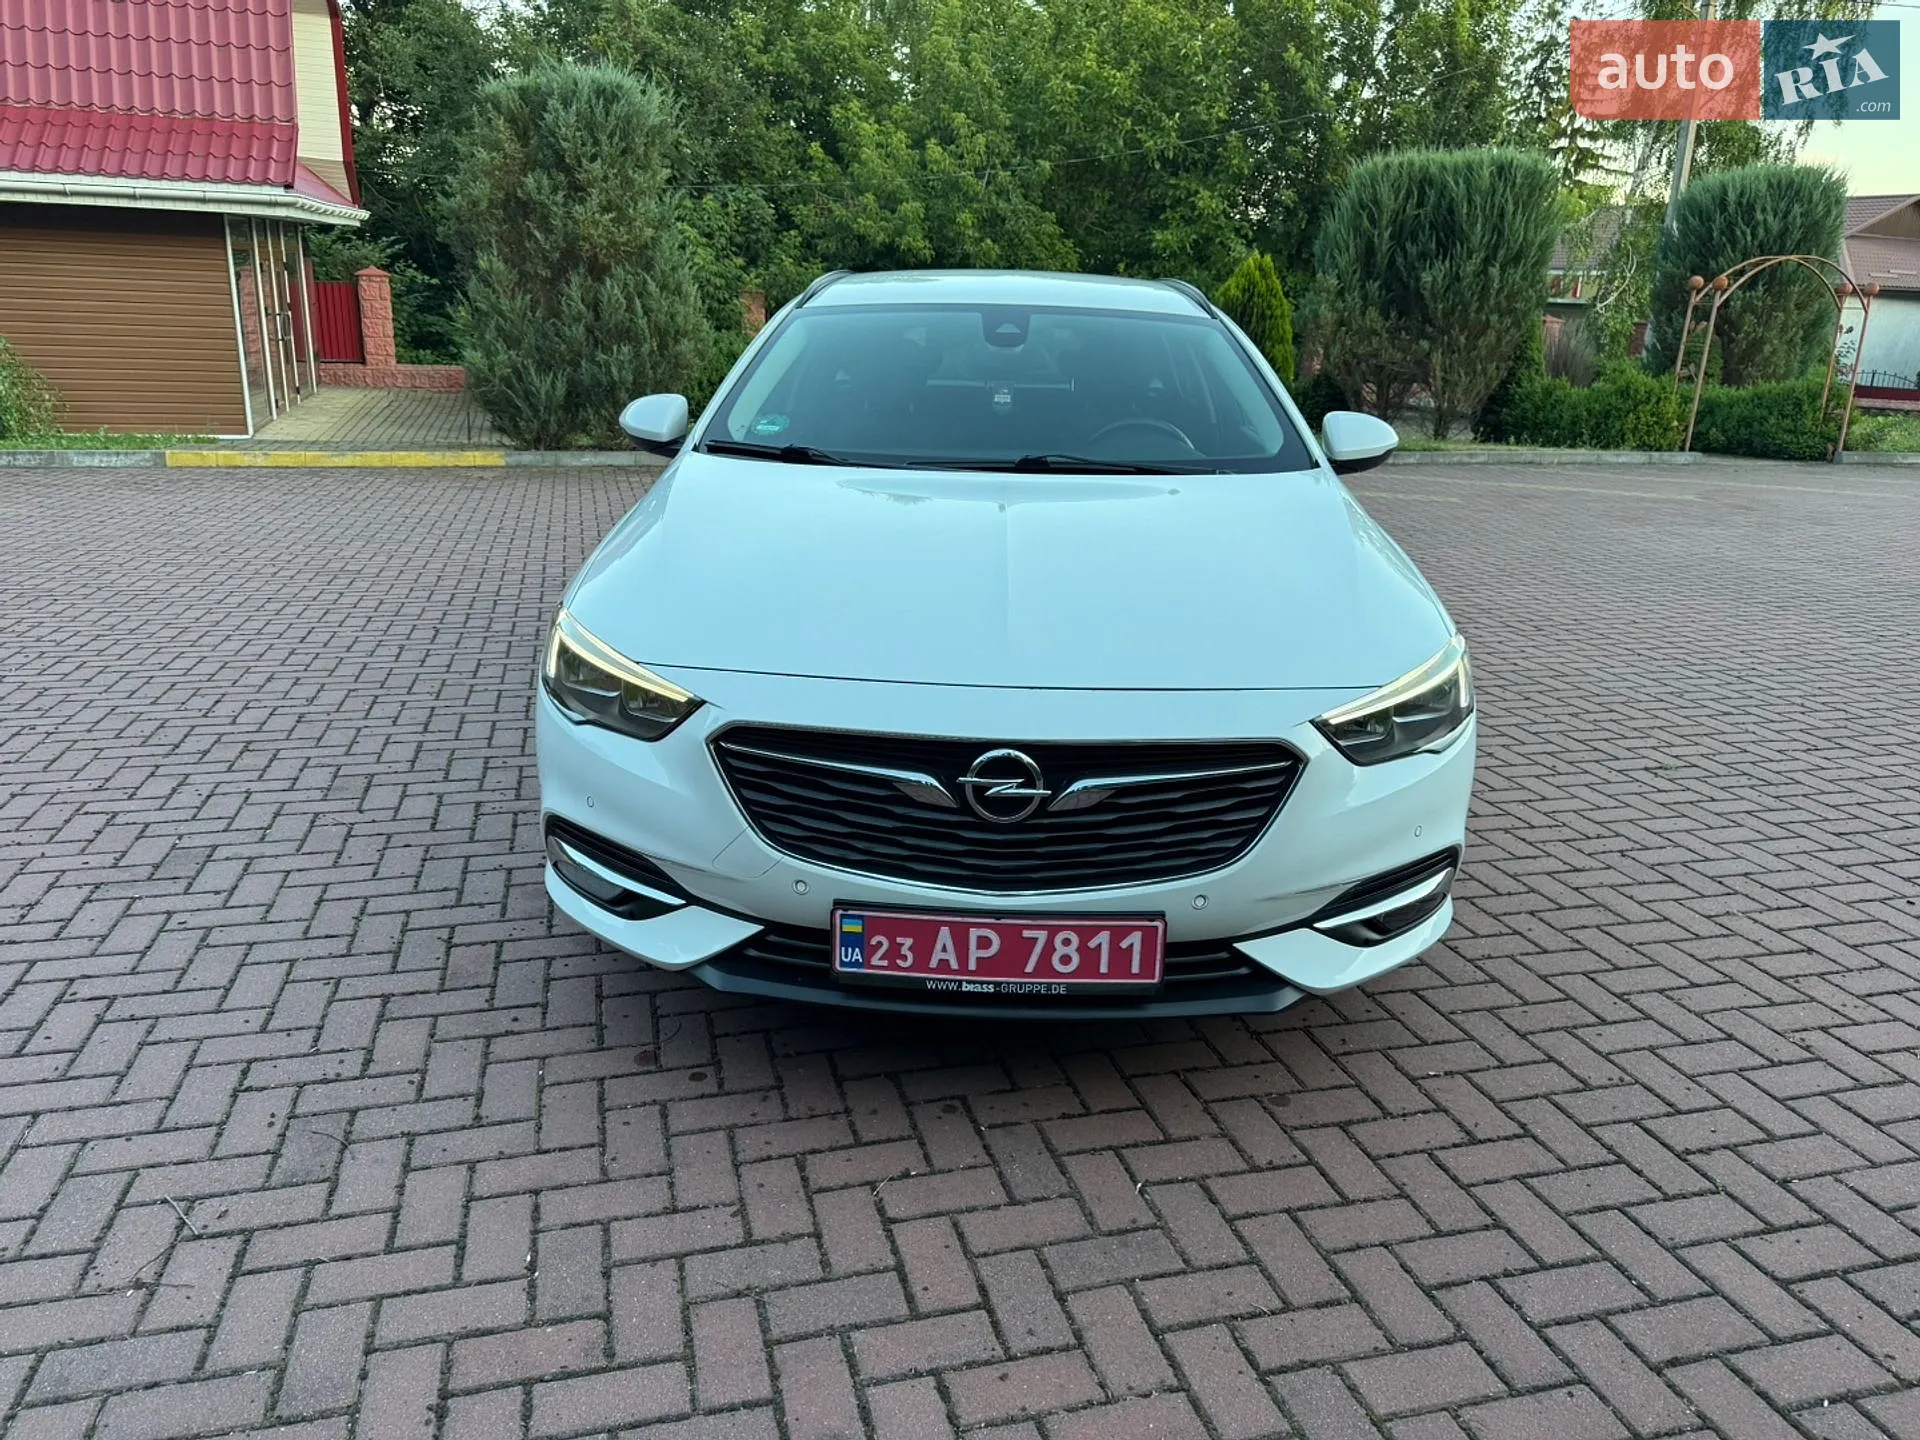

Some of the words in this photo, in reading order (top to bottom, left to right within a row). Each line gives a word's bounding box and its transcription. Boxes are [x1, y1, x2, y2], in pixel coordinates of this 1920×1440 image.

[841, 947, 863, 962] UA
[870, 935, 914, 968] 23
[928, 926, 1001, 971] AP
[1022, 929, 1142, 974] 7811
